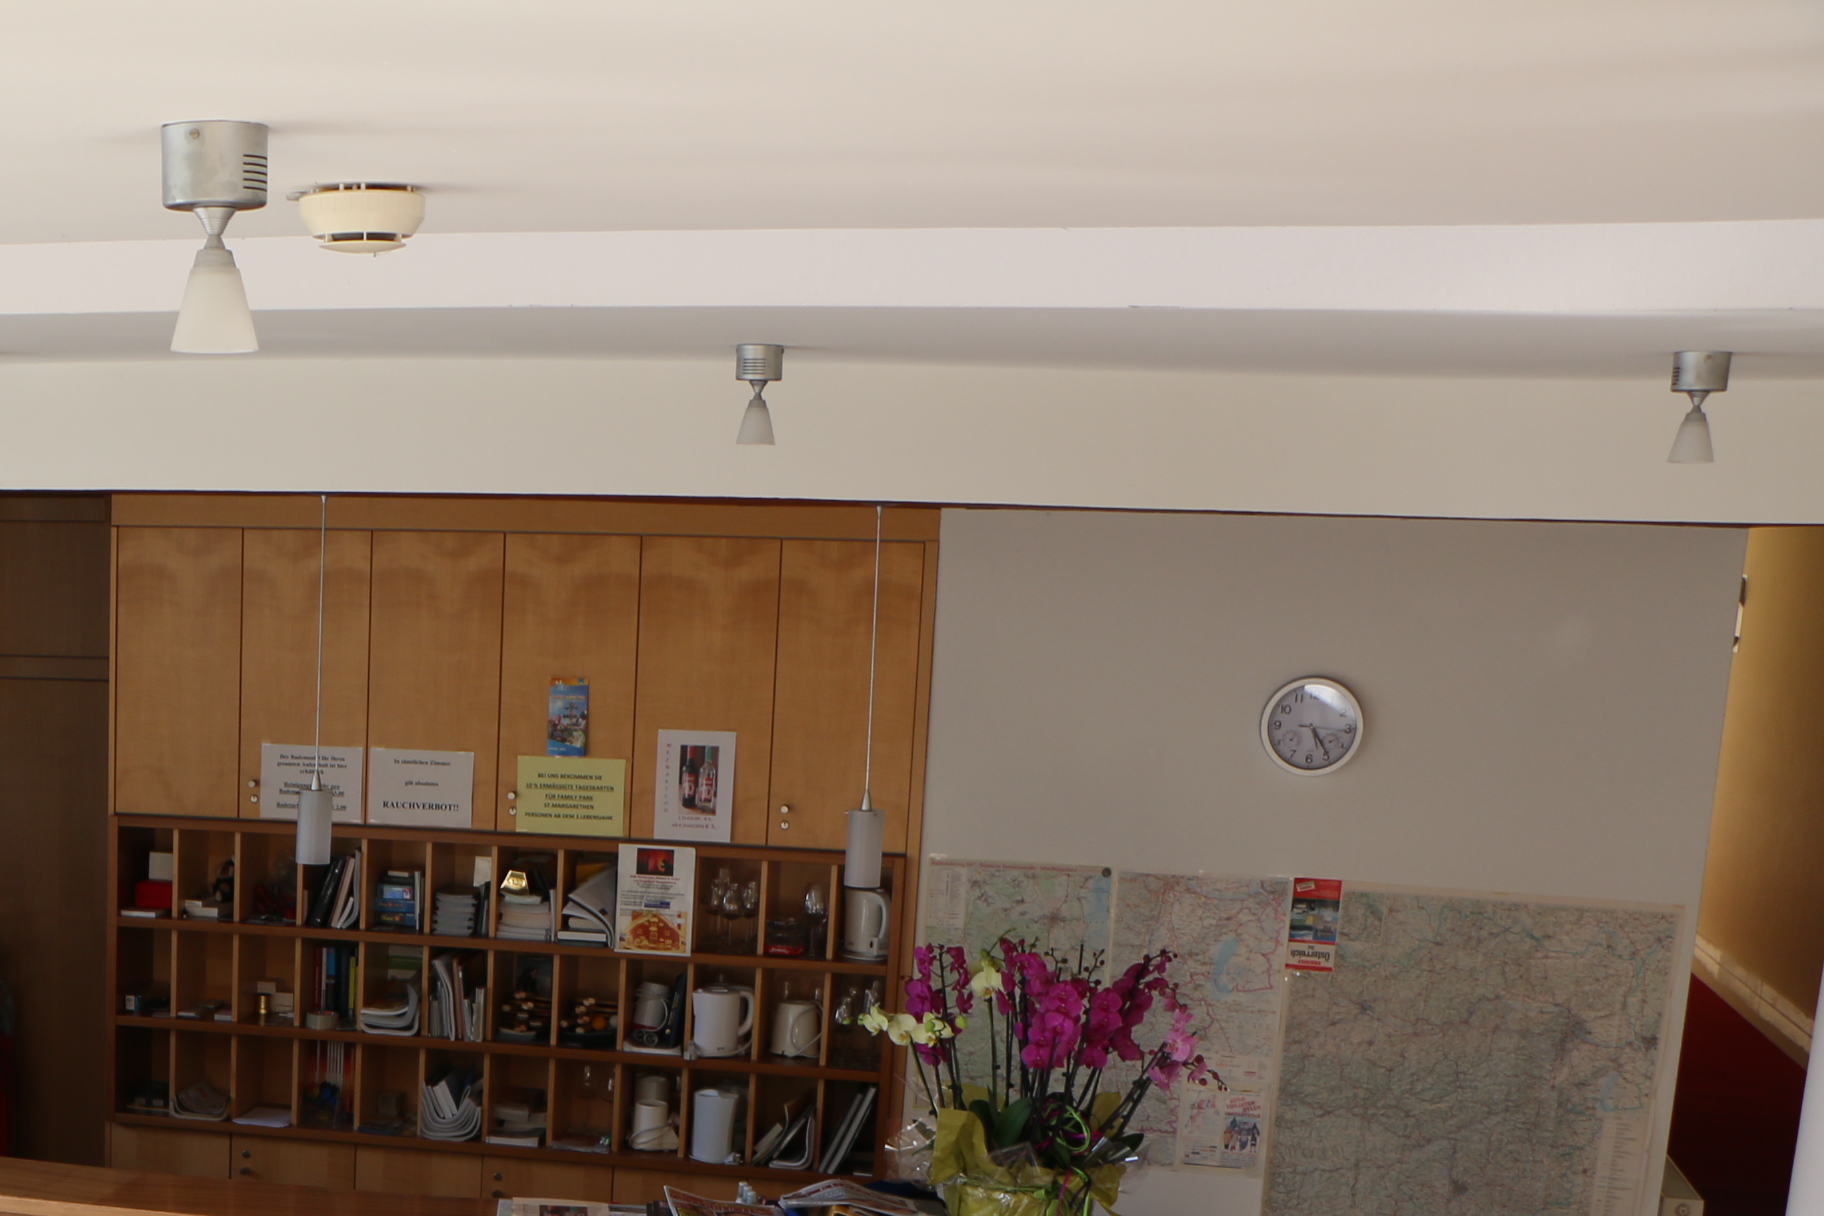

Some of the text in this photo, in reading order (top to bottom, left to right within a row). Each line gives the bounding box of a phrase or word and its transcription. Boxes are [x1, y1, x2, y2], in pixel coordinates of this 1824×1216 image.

[1294, 694, 1303, 703] 11
[1280, 705, 1291, 715] 10
[1274, 720, 1282, 730] 9
[1290, 749, 1296, 759] 7
[1305, 754, 1313, 764] 6
[1322, 752, 1330, 761] 5
[382, 800, 459, 812] RAUCHVERBOT!!
[1290, 949, 1330, 961] Österreich
